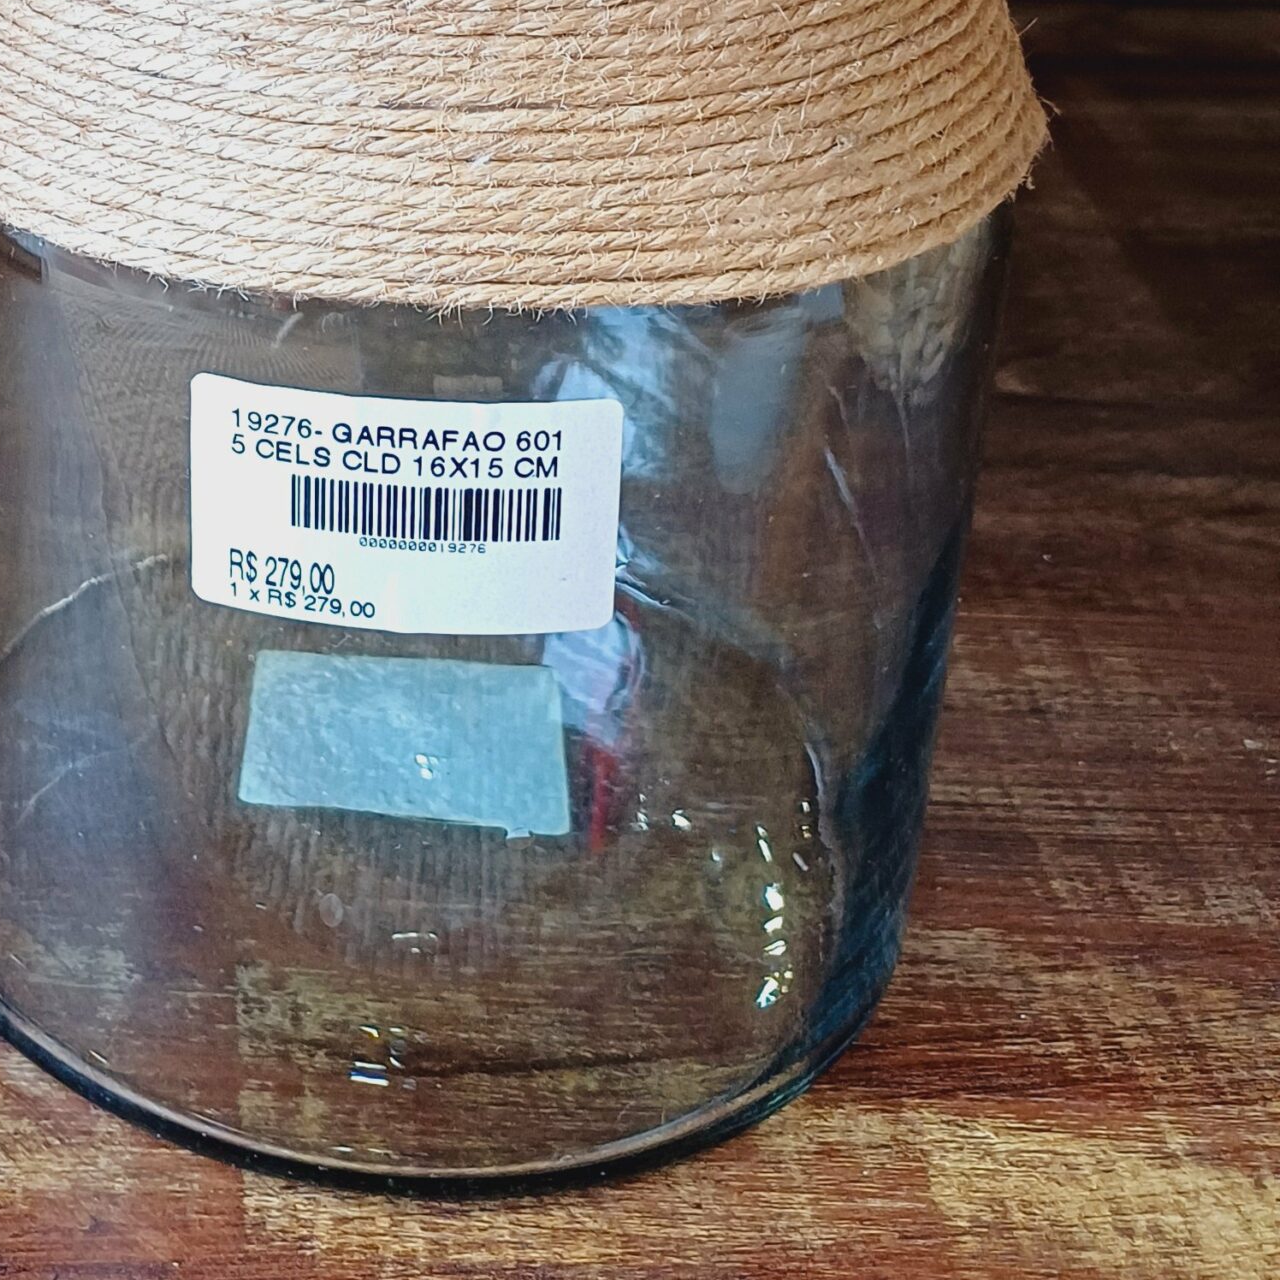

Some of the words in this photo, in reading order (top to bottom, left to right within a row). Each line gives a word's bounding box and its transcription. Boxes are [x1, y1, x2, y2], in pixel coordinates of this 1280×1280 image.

[231, 408, 323, 439] 19276-
[332, 422, 506, 452] GARRAFAO
[515, 430, 563, 452] 601
[231, 433, 246, 455] 5
[255, 438, 331, 468] CELS
[342, 450, 401, 475] CLD
[413, 456, 504, 479] 16X15
[514, 456, 559, 479] CM
[358, 536, 487, 554] 0000000019276
[229, 548, 258, 584] R$
[265, 556, 335, 596] 279,00
[230, 582, 238, 597] 1
[249, 589, 260, 602] x
[268, 588, 297, 609] R$
[304, 594, 376, 619] 279,00
